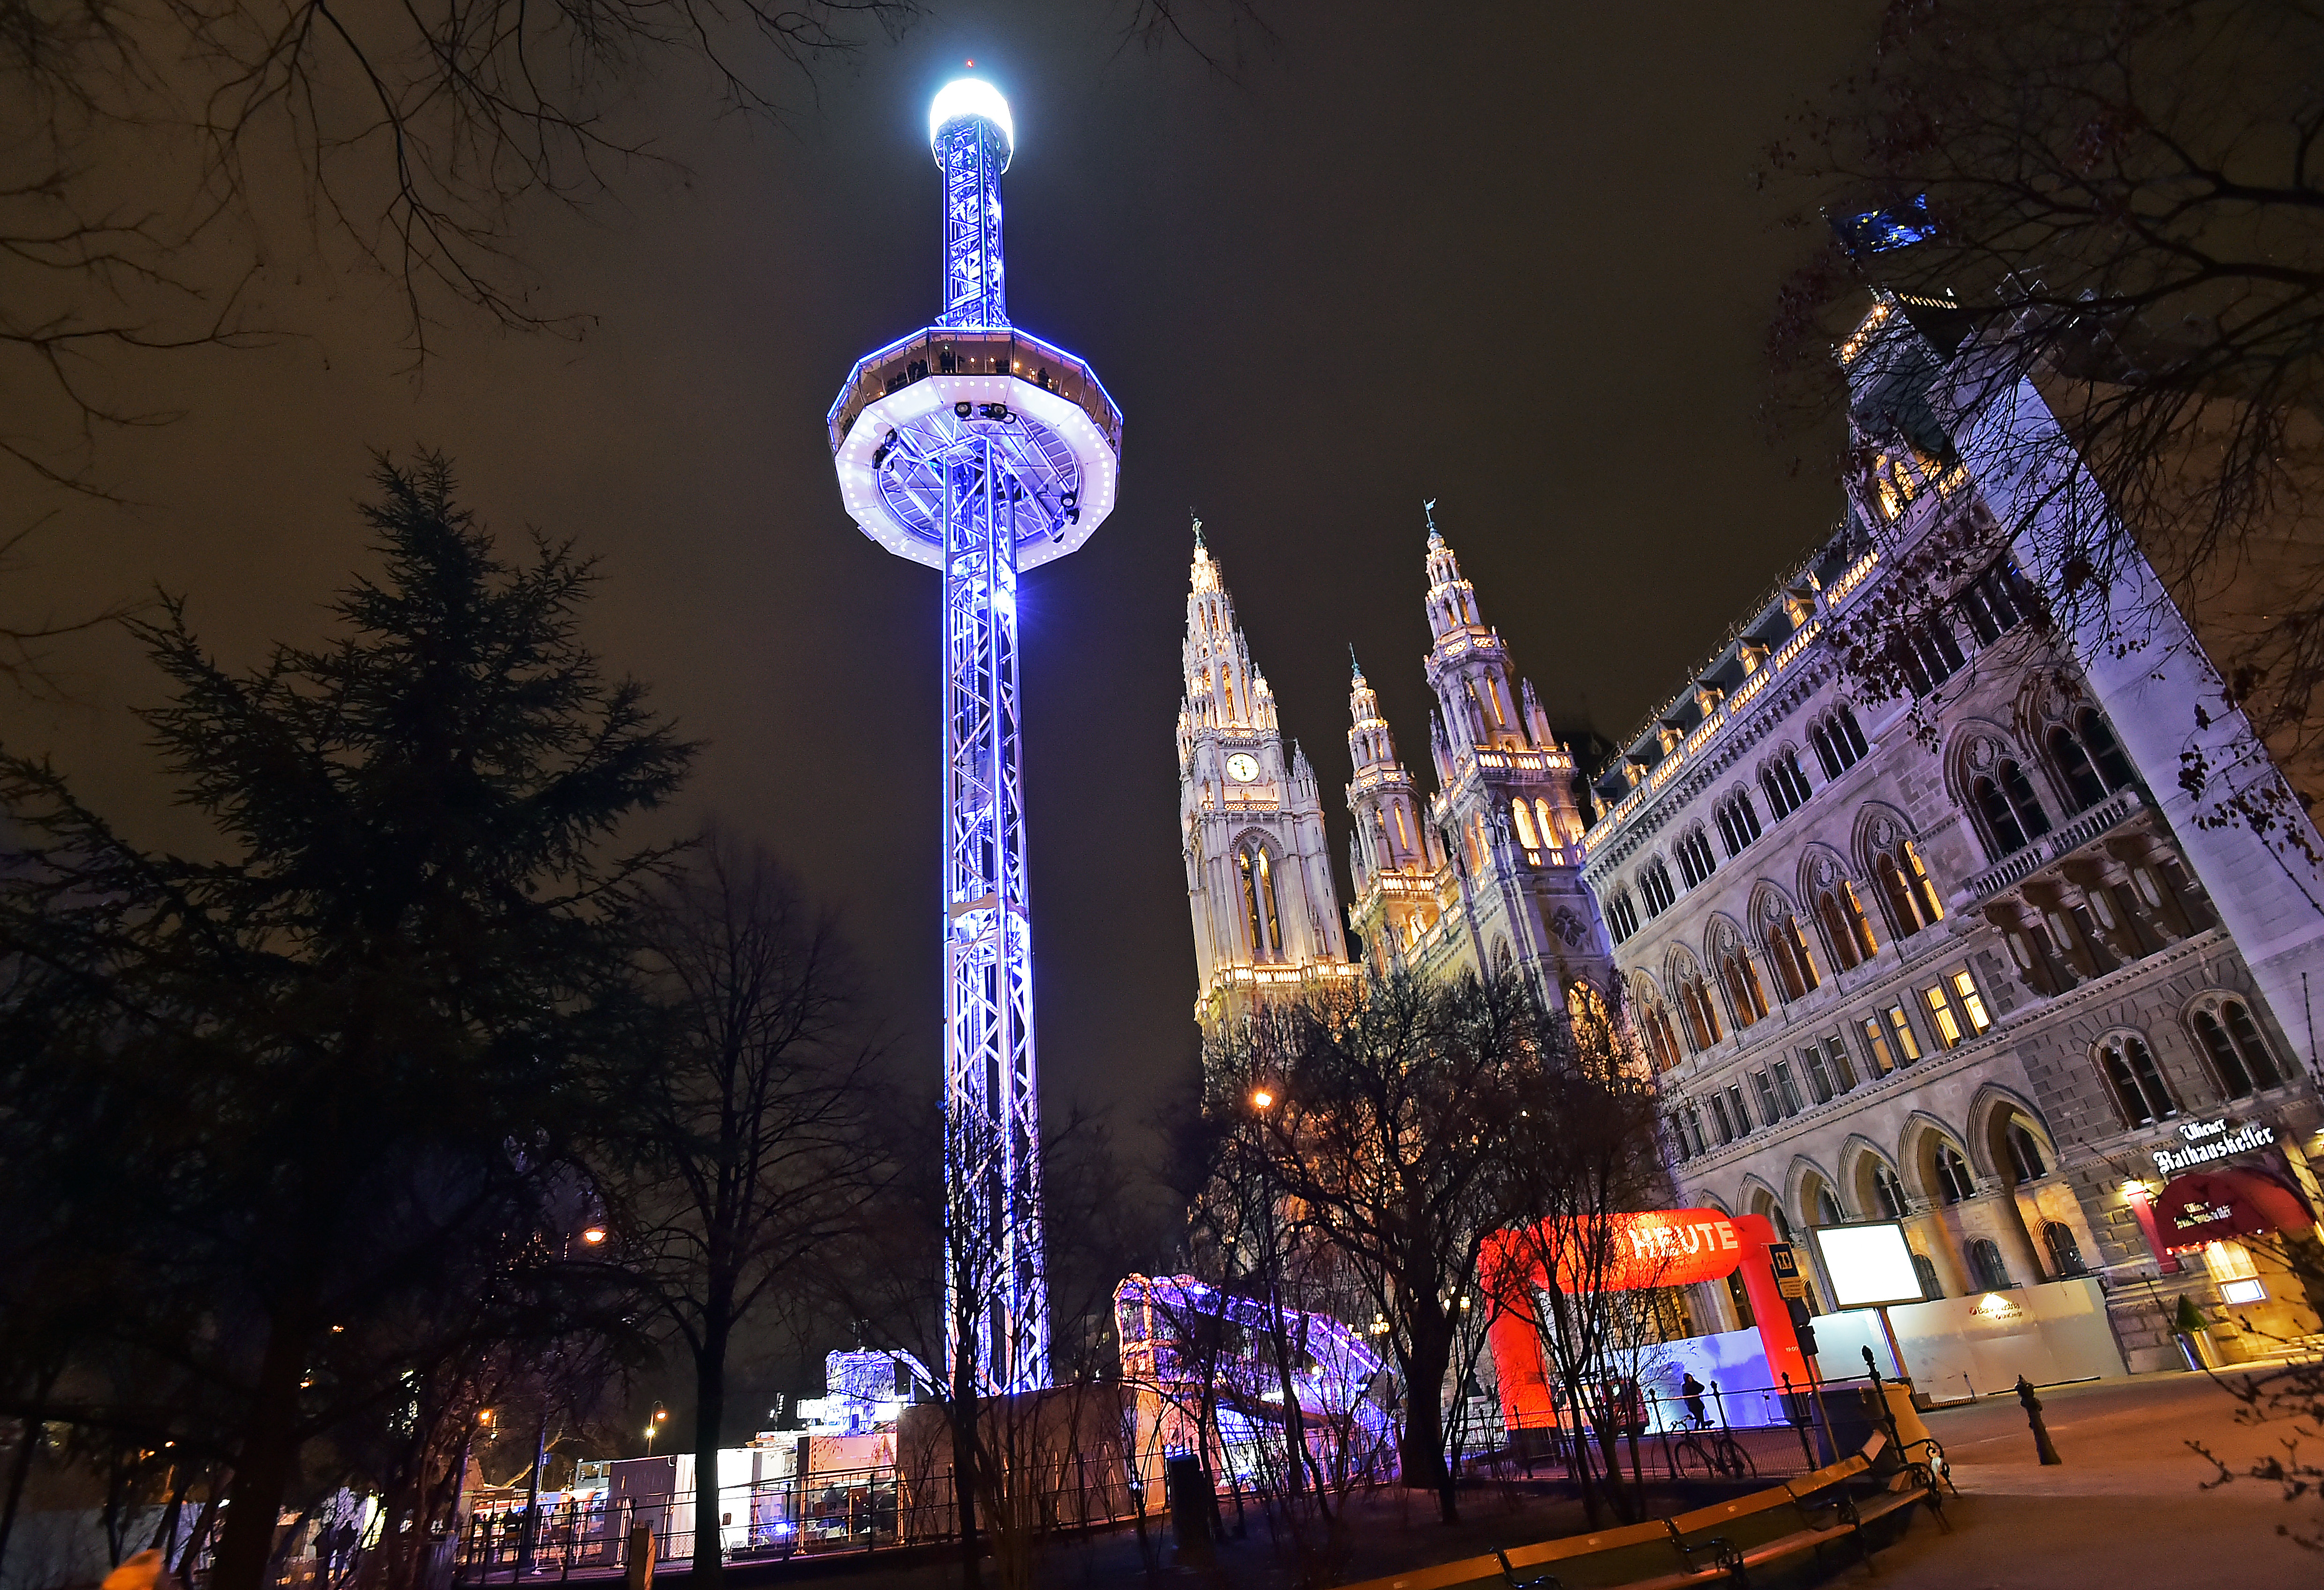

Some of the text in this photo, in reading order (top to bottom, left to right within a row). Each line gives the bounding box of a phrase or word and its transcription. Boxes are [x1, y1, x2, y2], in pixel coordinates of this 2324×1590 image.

[2179, 1118, 2226, 1140] Wiener
[2152, 1127, 2274, 1174] Rathauskeller
[1628, 1221, 1738, 1259] HEUTE
